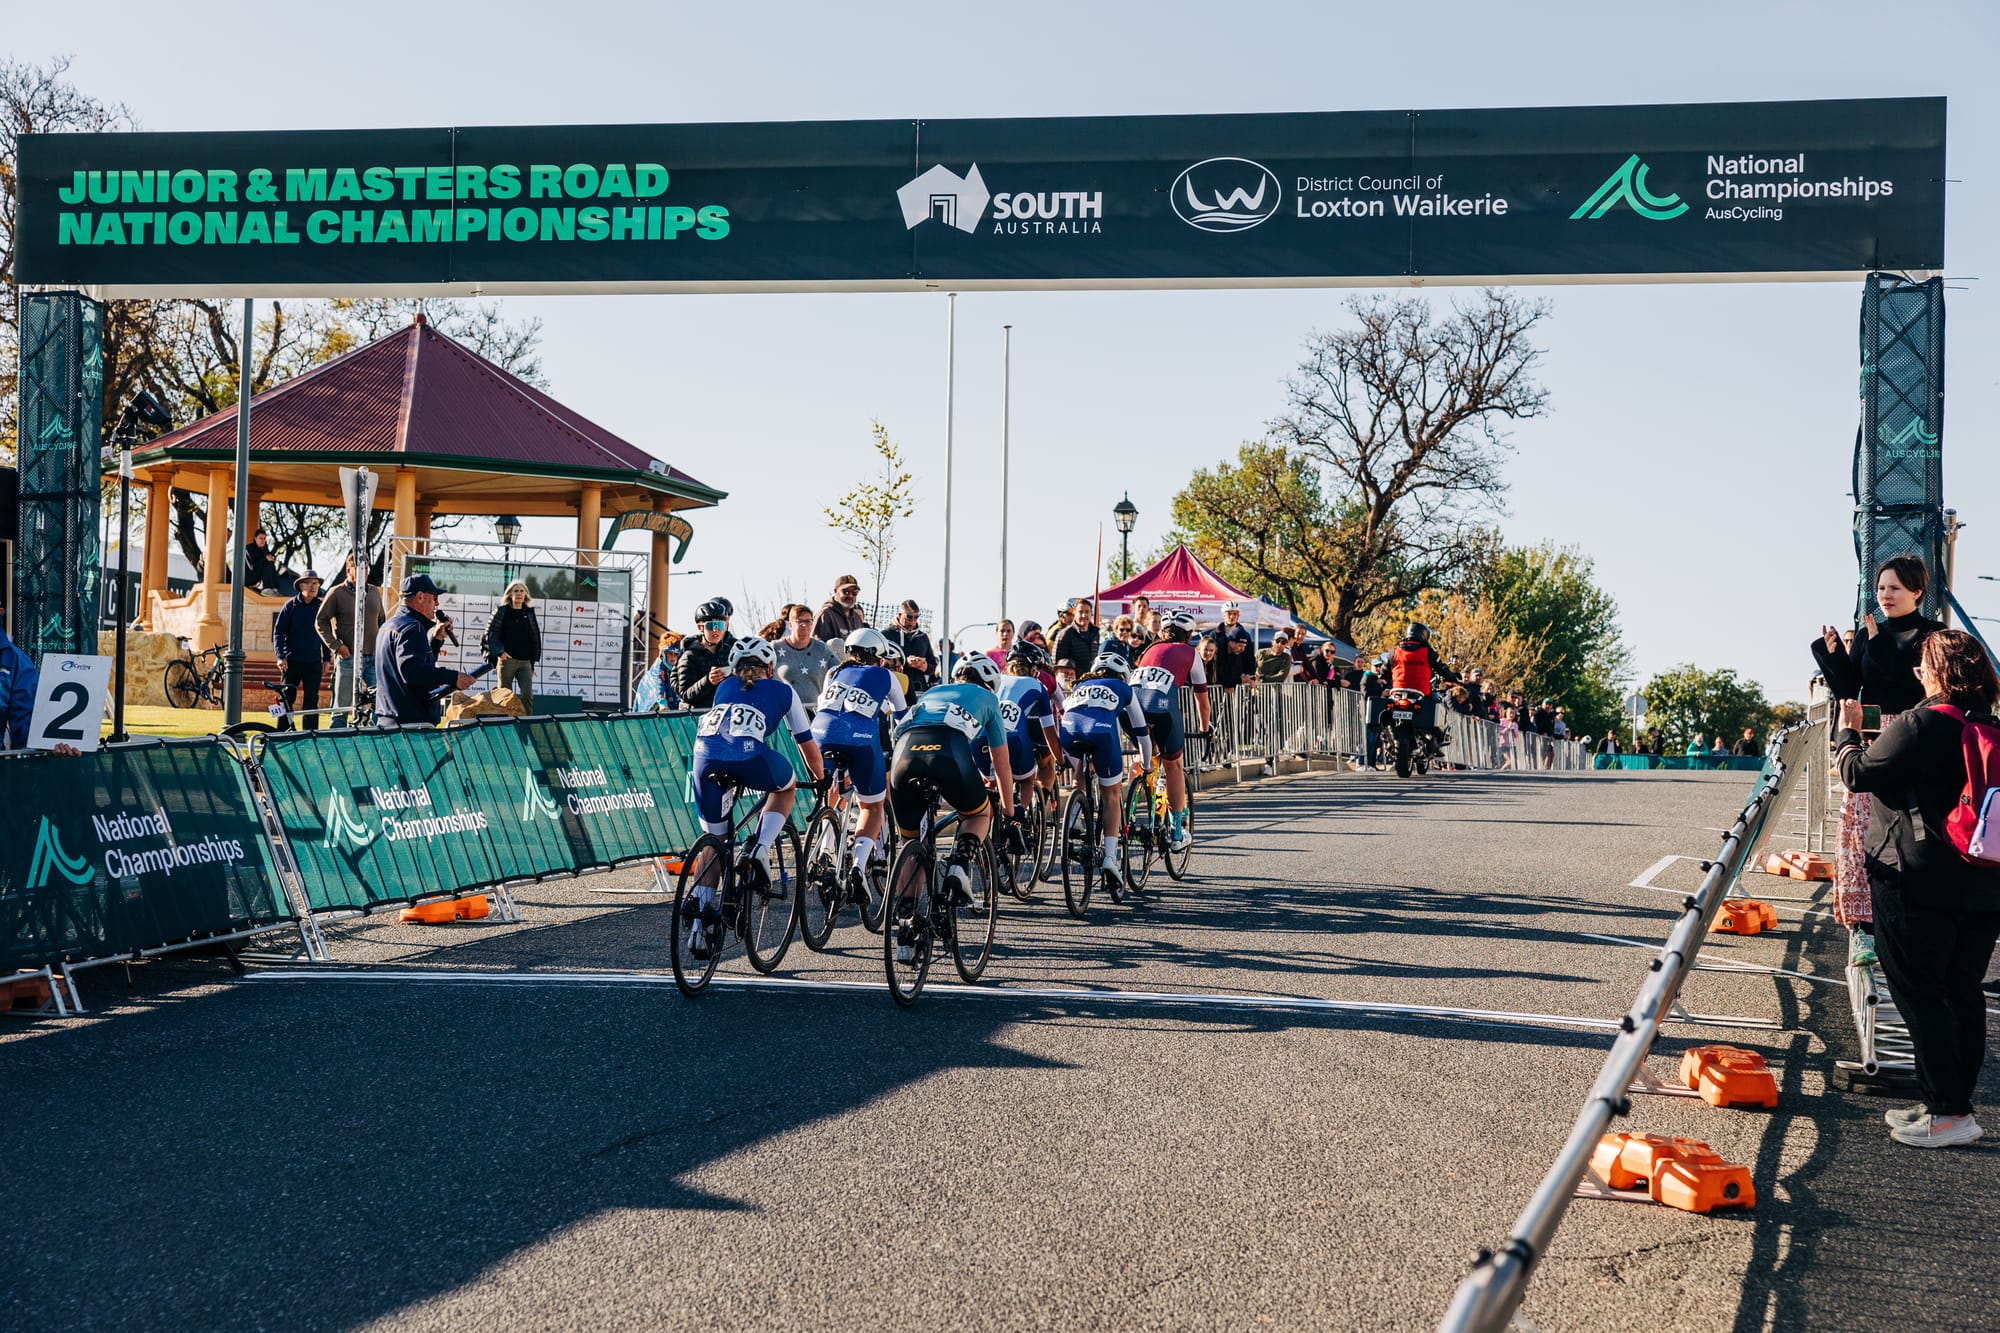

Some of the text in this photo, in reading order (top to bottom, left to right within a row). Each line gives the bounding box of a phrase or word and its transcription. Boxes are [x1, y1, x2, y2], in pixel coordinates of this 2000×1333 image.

[1707, 153, 1804, 175] National
[59, 163, 669, 204] JUNIOR & MASTERS ROAD
[1297, 174, 1444, 192] District Council of
[1706, 176, 1894, 203] Championships
[993, 191, 1102, 220] SOUTH
[1297, 192, 1509, 218] Loxton Waikerie
[1705, 205, 1783, 222] AusCycling
[59, 204, 729, 245] NATIONAL CHAMPIONSHIPS
[994, 221, 1101, 234] AUSTRALIA
[1147, 667, 1171, 685] 371
[42, 681, 89, 741] 2
[733, 707, 764, 730] 375
[1000, 703, 1019, 722] 63
[556, 764, 607, 788] National
[370, 782, 432, 811] National
[567, 787, 655, 817] Championships
[92, 806, 172, 843] National
[382, 807, 488, 843] Championships
[105, 834, 244, 879] Championships
